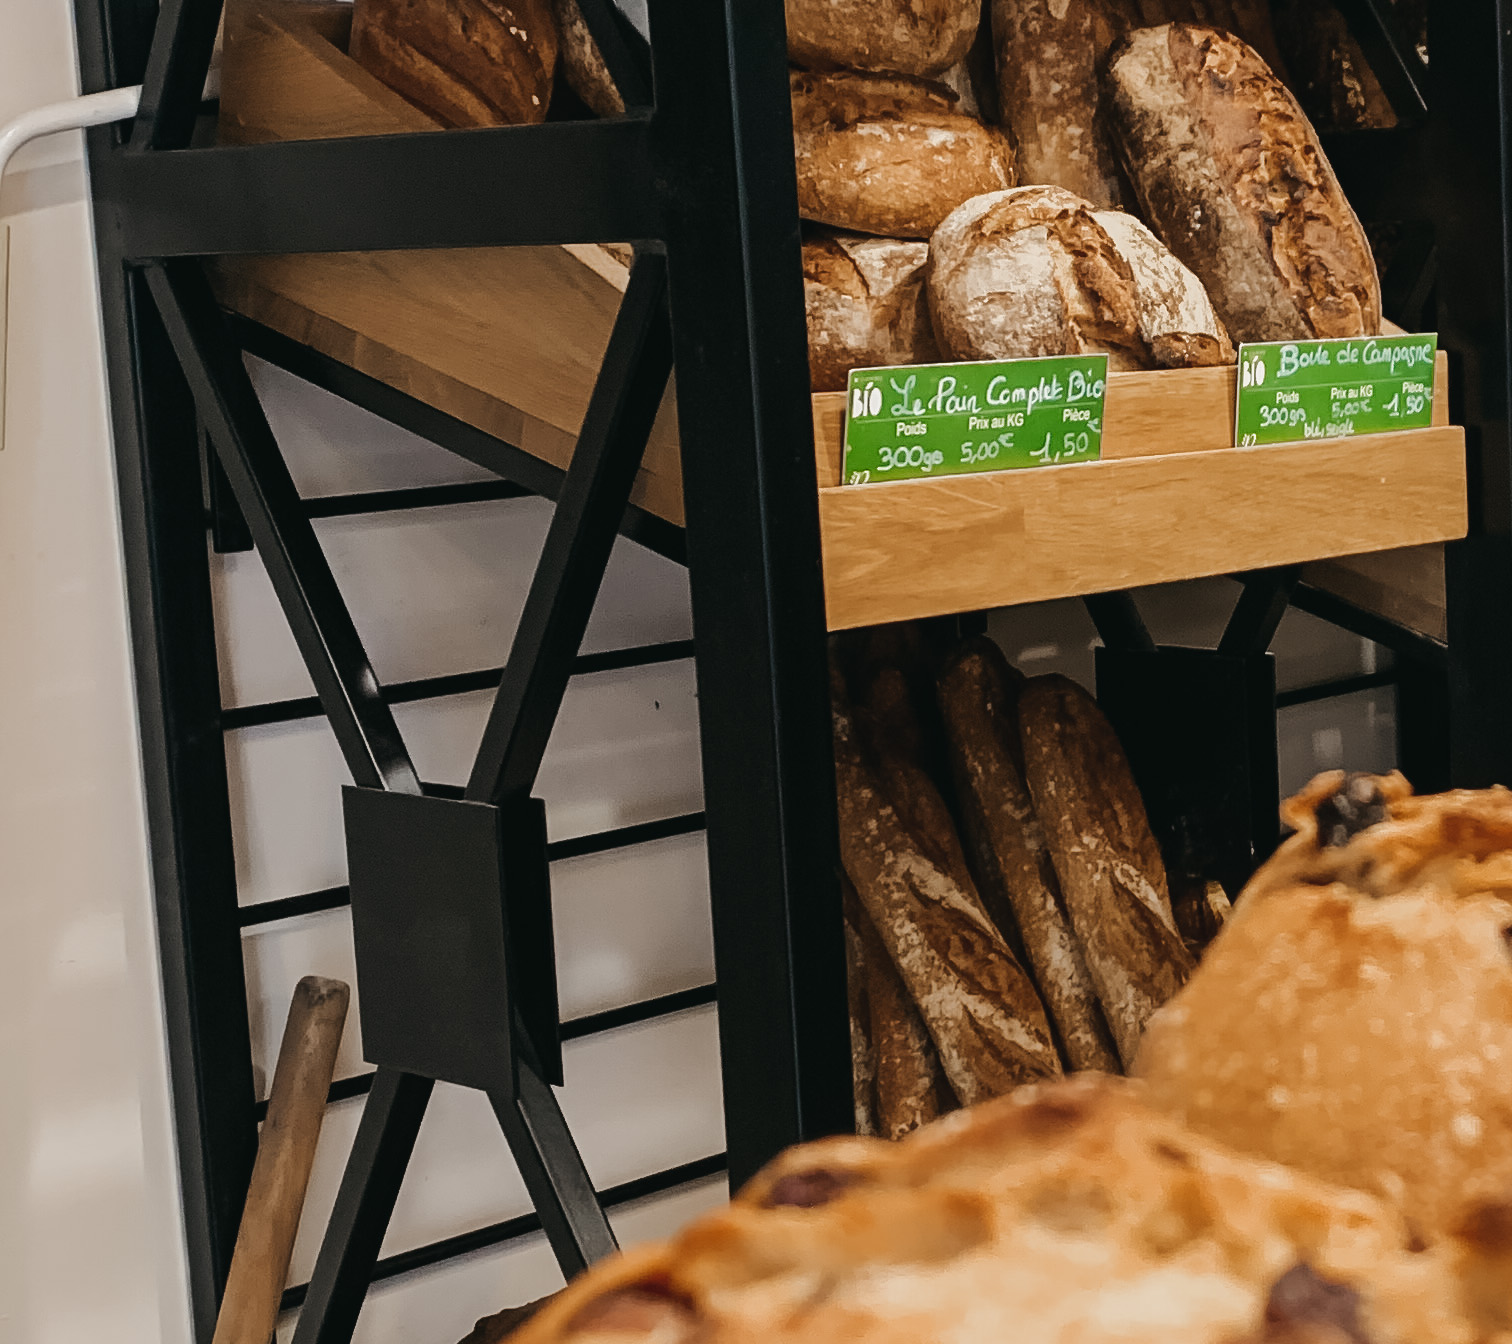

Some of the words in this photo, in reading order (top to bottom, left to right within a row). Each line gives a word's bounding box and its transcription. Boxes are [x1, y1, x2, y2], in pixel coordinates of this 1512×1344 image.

[1336, 342, 1359, 364] de
[1362, 340, 1433, 375] Campagne
[890, 375, 926, 416] Le
[928, 376, 981, 414] Pain
[986, 374, 1064, 415] Complet
[1066, 369, 1104, 402] Bio
[1276, 391, 1299, 404] Poids
[1330, 387, 1347, 400] Prix
[1348, 389, 1359, 399] au
[1359, 384, 1373, 397] KG
[1402, 382, 1424, 394] Pièce
[896, 421, 927, 437] Poids
[968, 415, 990, 431] Prix
[991, 417, 1005, 428] au
[1006, 412, 1024, 427] KG
[1062, 408, 1091, 422] Pièce
